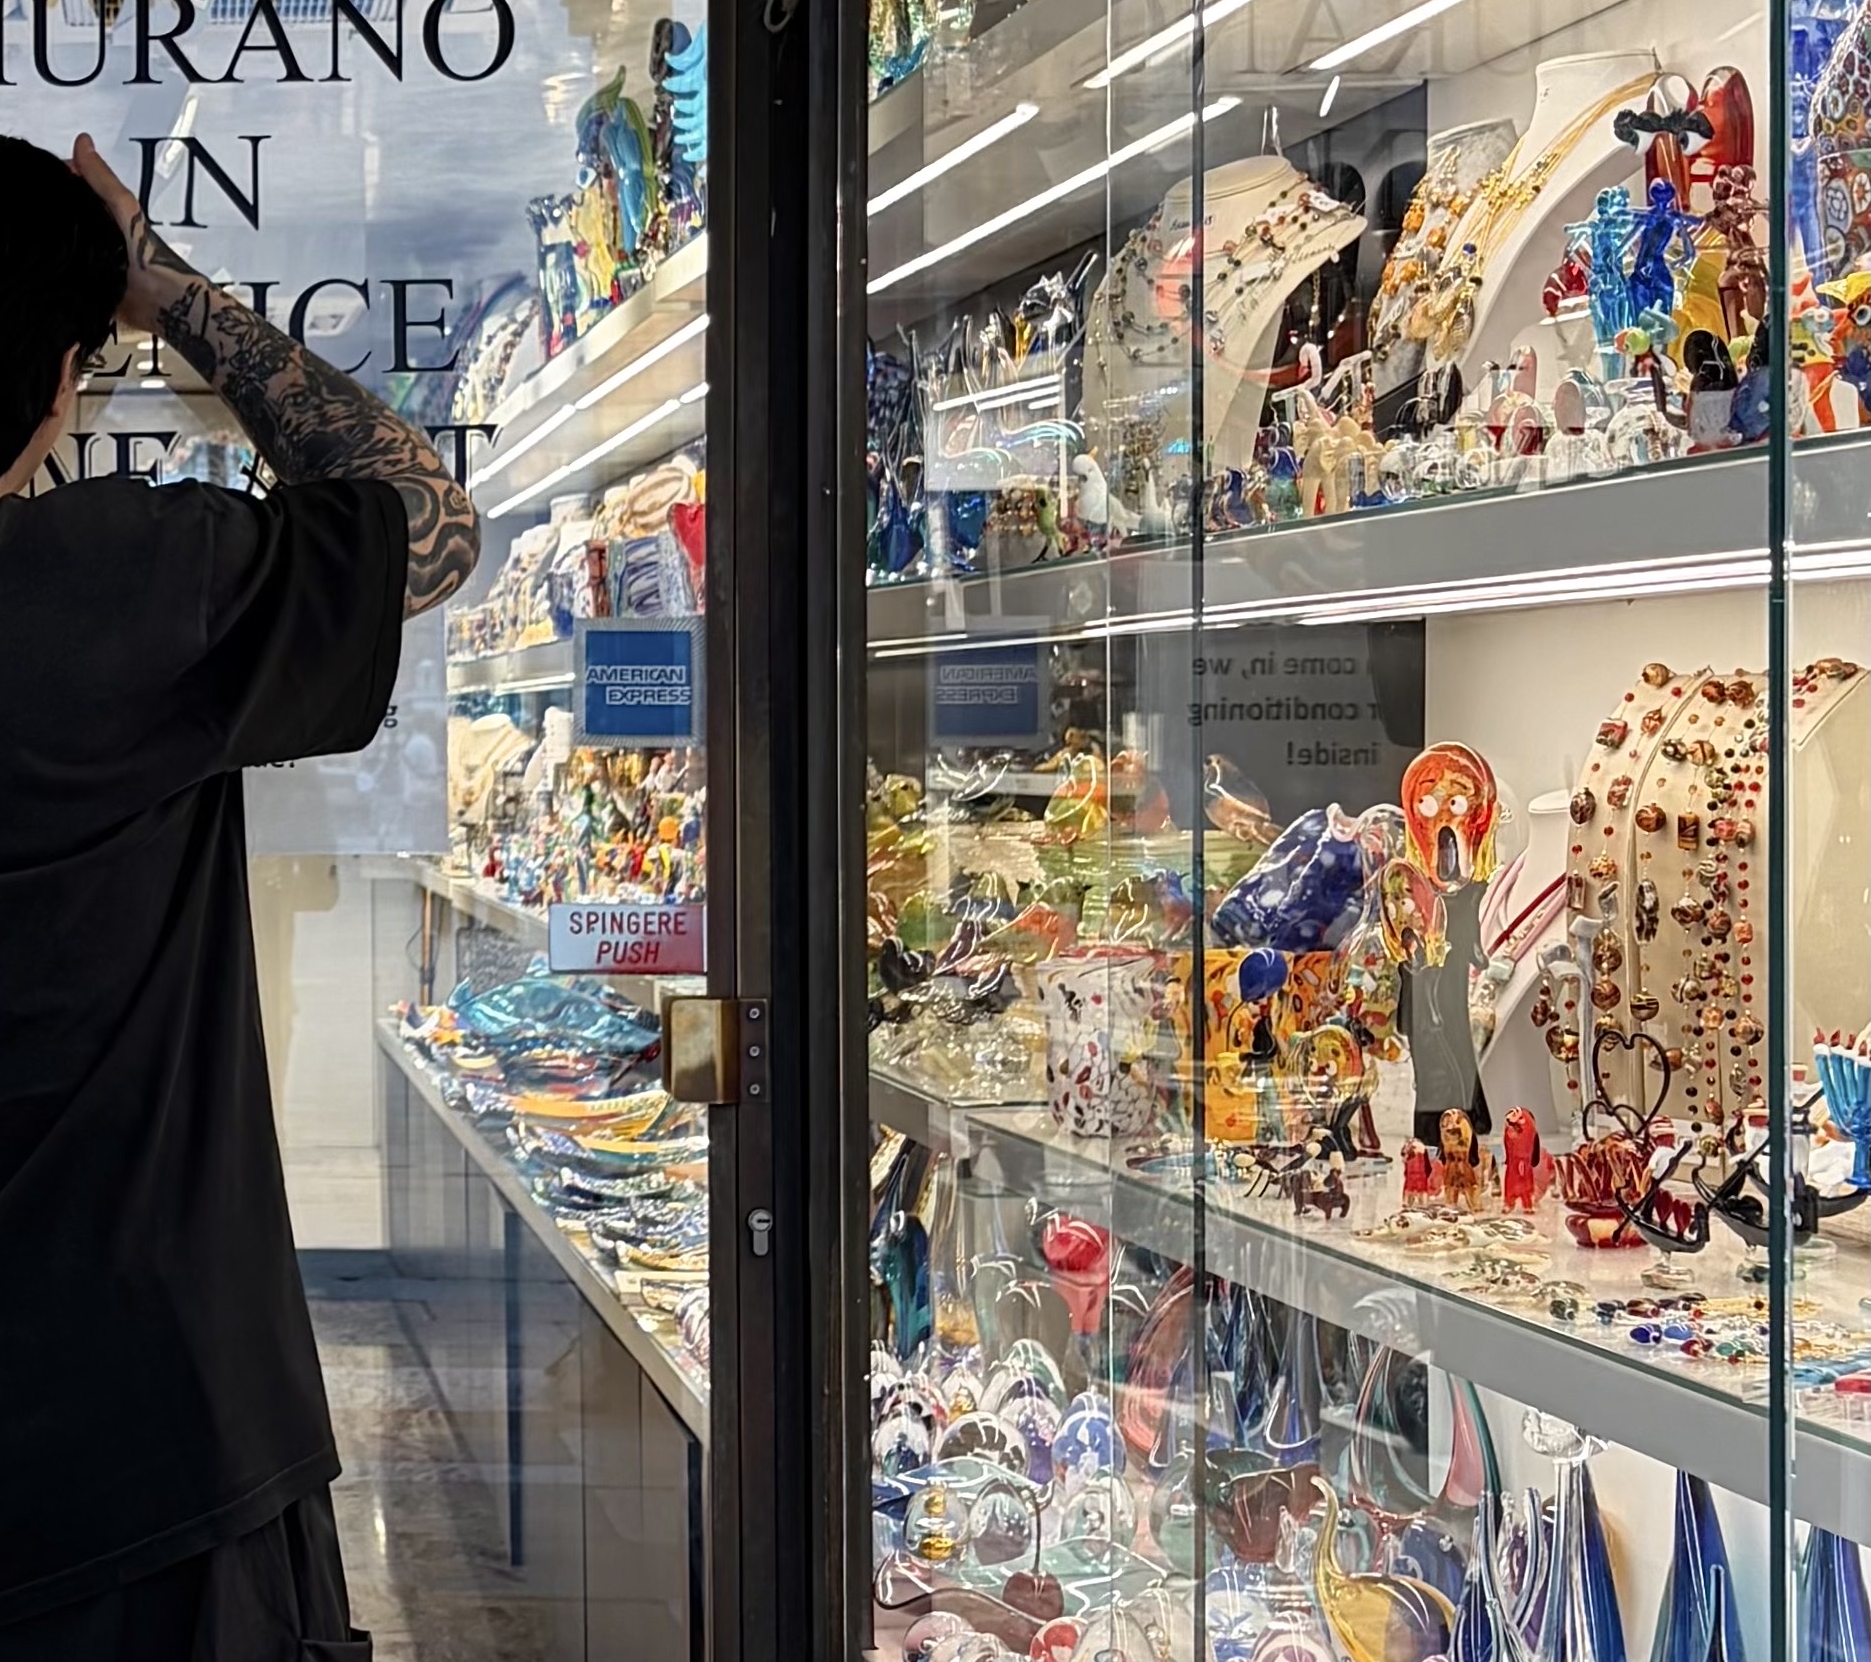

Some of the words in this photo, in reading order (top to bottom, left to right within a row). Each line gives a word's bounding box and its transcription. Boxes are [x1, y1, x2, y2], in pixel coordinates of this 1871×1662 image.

[129, 135, 272, 231] IN
[586, 666, 686, 684] AMERICAN
[606, 686, 692, 705] EXPRESS
[569, 911, 688, 935] SPINGERE
[596, 940, 661, 965] PUSH
